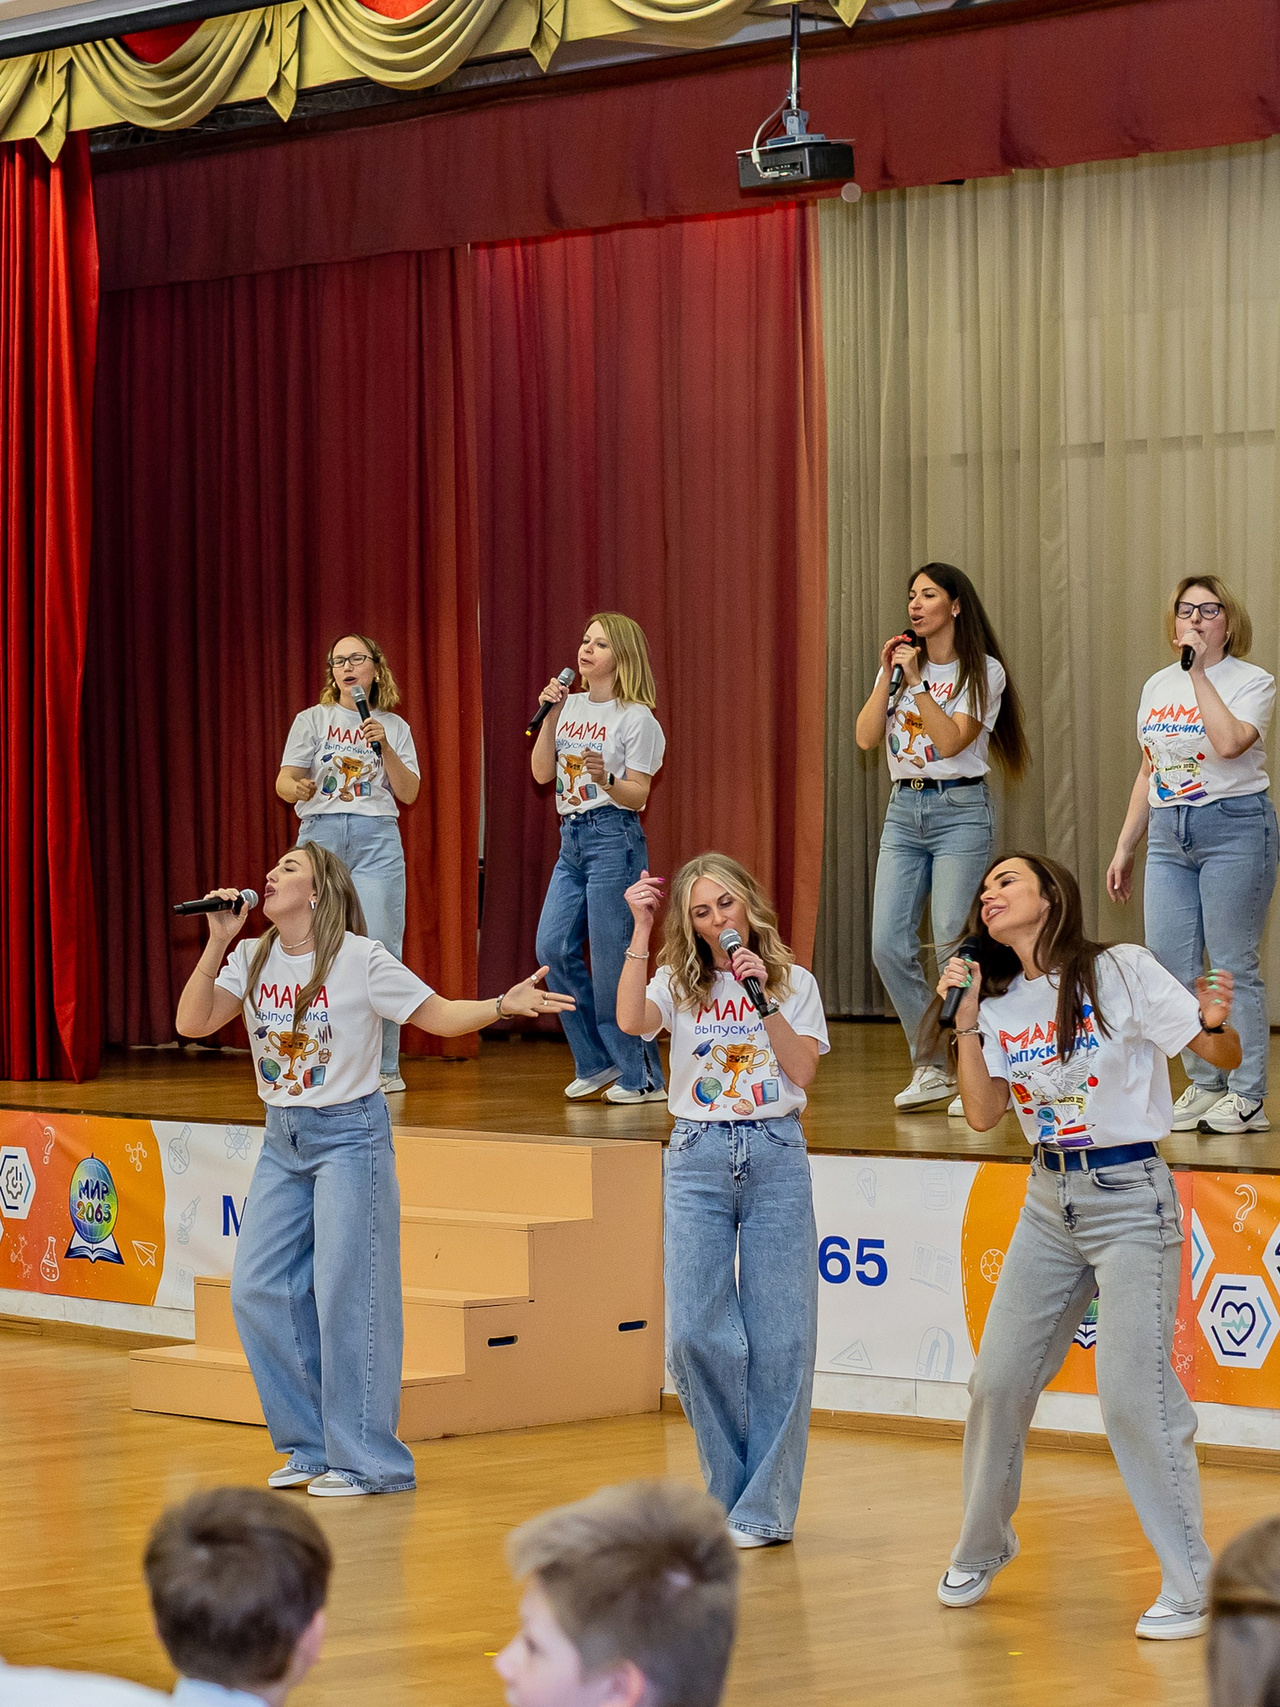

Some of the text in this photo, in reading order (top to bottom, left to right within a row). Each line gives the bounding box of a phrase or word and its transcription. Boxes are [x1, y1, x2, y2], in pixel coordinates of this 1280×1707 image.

[928, 682, 954, 699] МА
[327, 725, 374, 749] МАМ
[557, 721, 607, 741] МАМА
[696, 996, 756, 1024] МАМ
[77, 1178, 110, 1201] МИР
[76, 1200, 112, 1224] 2065
